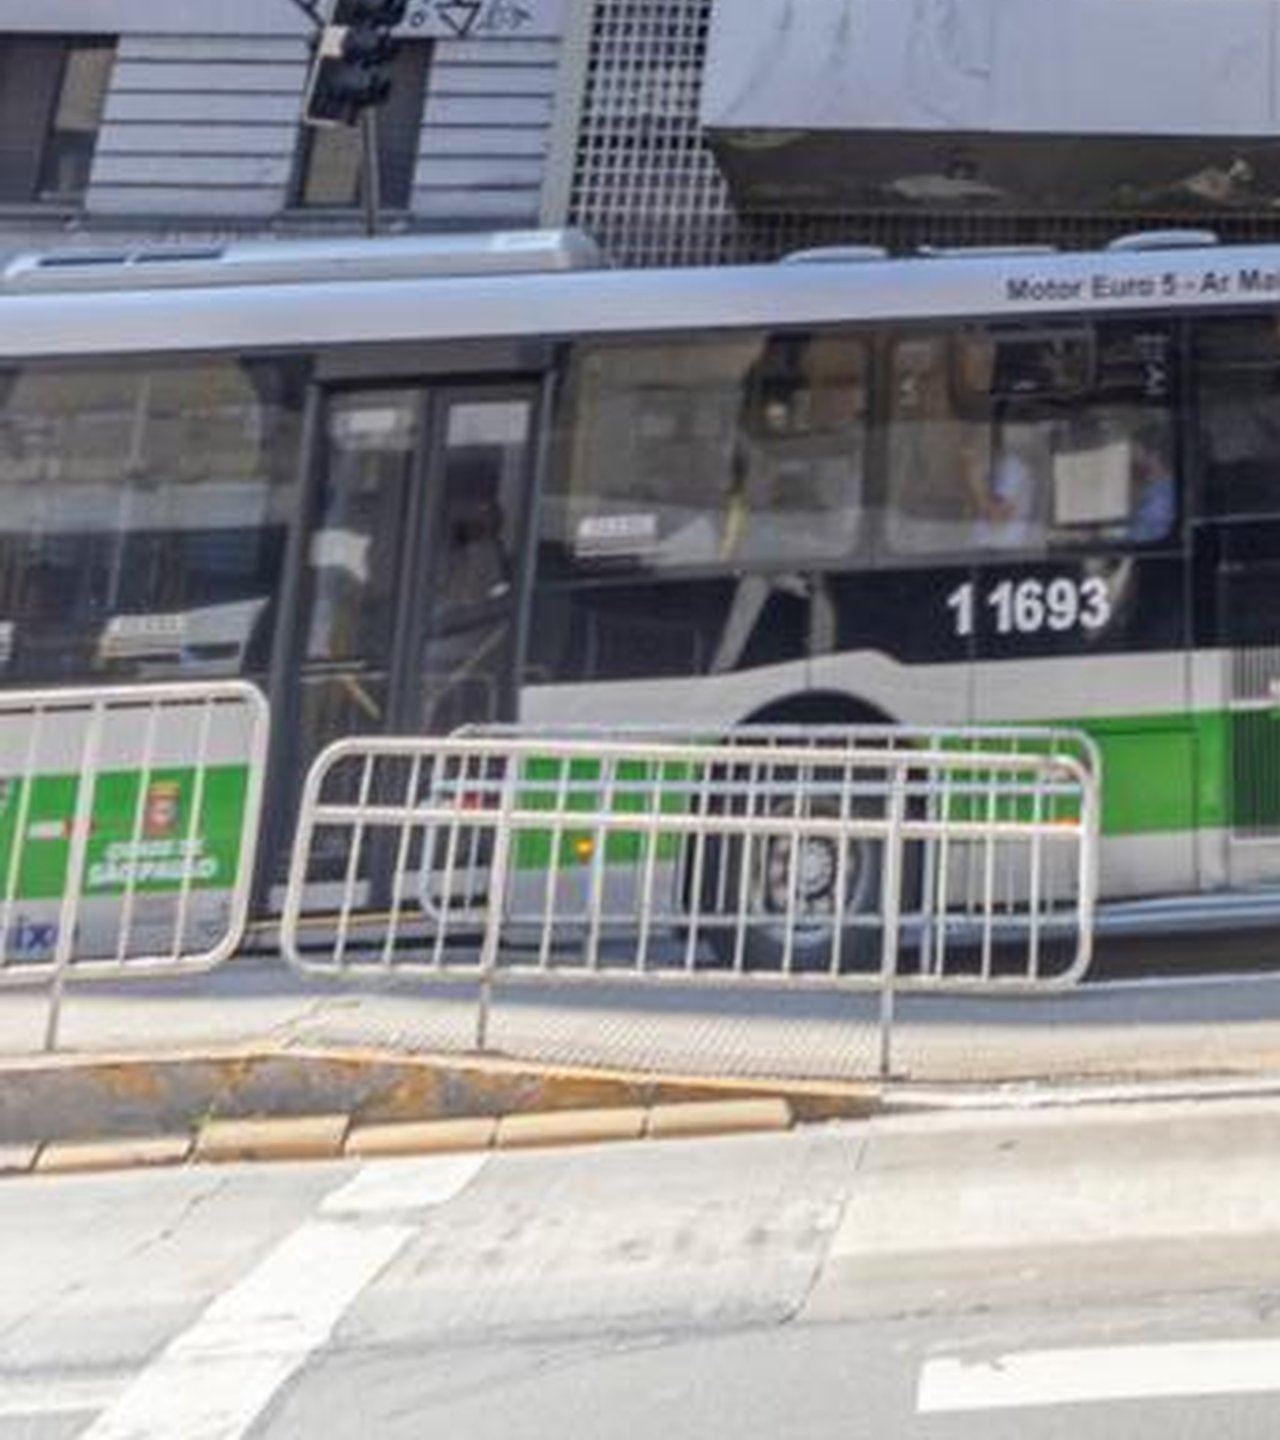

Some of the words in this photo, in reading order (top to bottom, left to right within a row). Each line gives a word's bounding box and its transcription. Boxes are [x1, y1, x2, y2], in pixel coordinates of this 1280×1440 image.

[1006, 277, 1081, 300] Motor
[1091, 275, 1155, 298] Euro
[1162, 273, 1176, 296] 5
[1200, 272, 1230, 293] Ar
[947, 583, 973, 635] 1
[988, 576, 1110, 633] 1693
